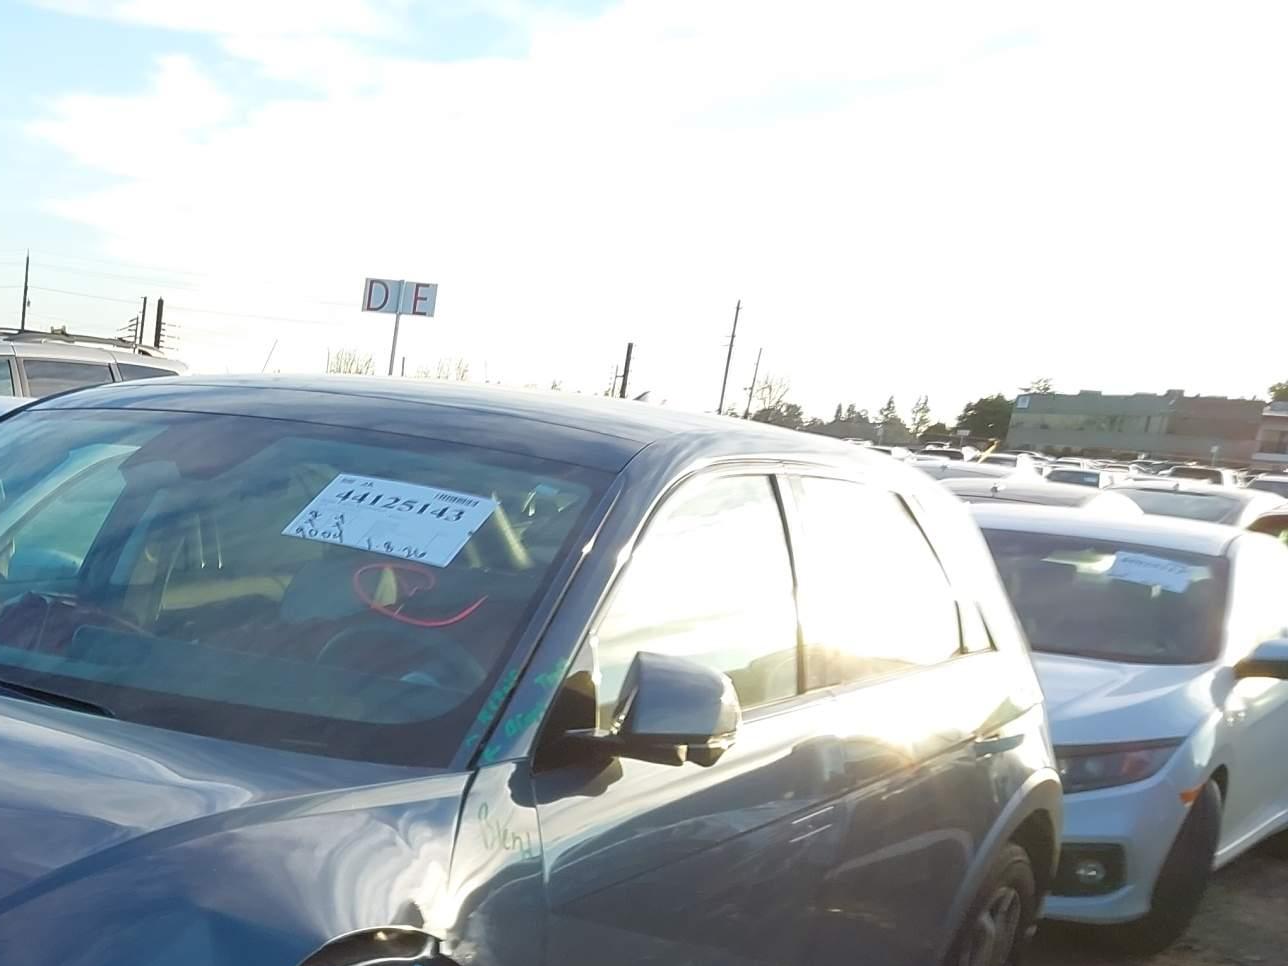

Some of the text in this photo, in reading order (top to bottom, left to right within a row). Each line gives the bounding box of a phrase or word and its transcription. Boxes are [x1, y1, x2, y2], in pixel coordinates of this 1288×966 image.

[367, 280, 389, 311] D
[413, 284, 430, 315] E
[336, 489, 465, 522] 44125143
